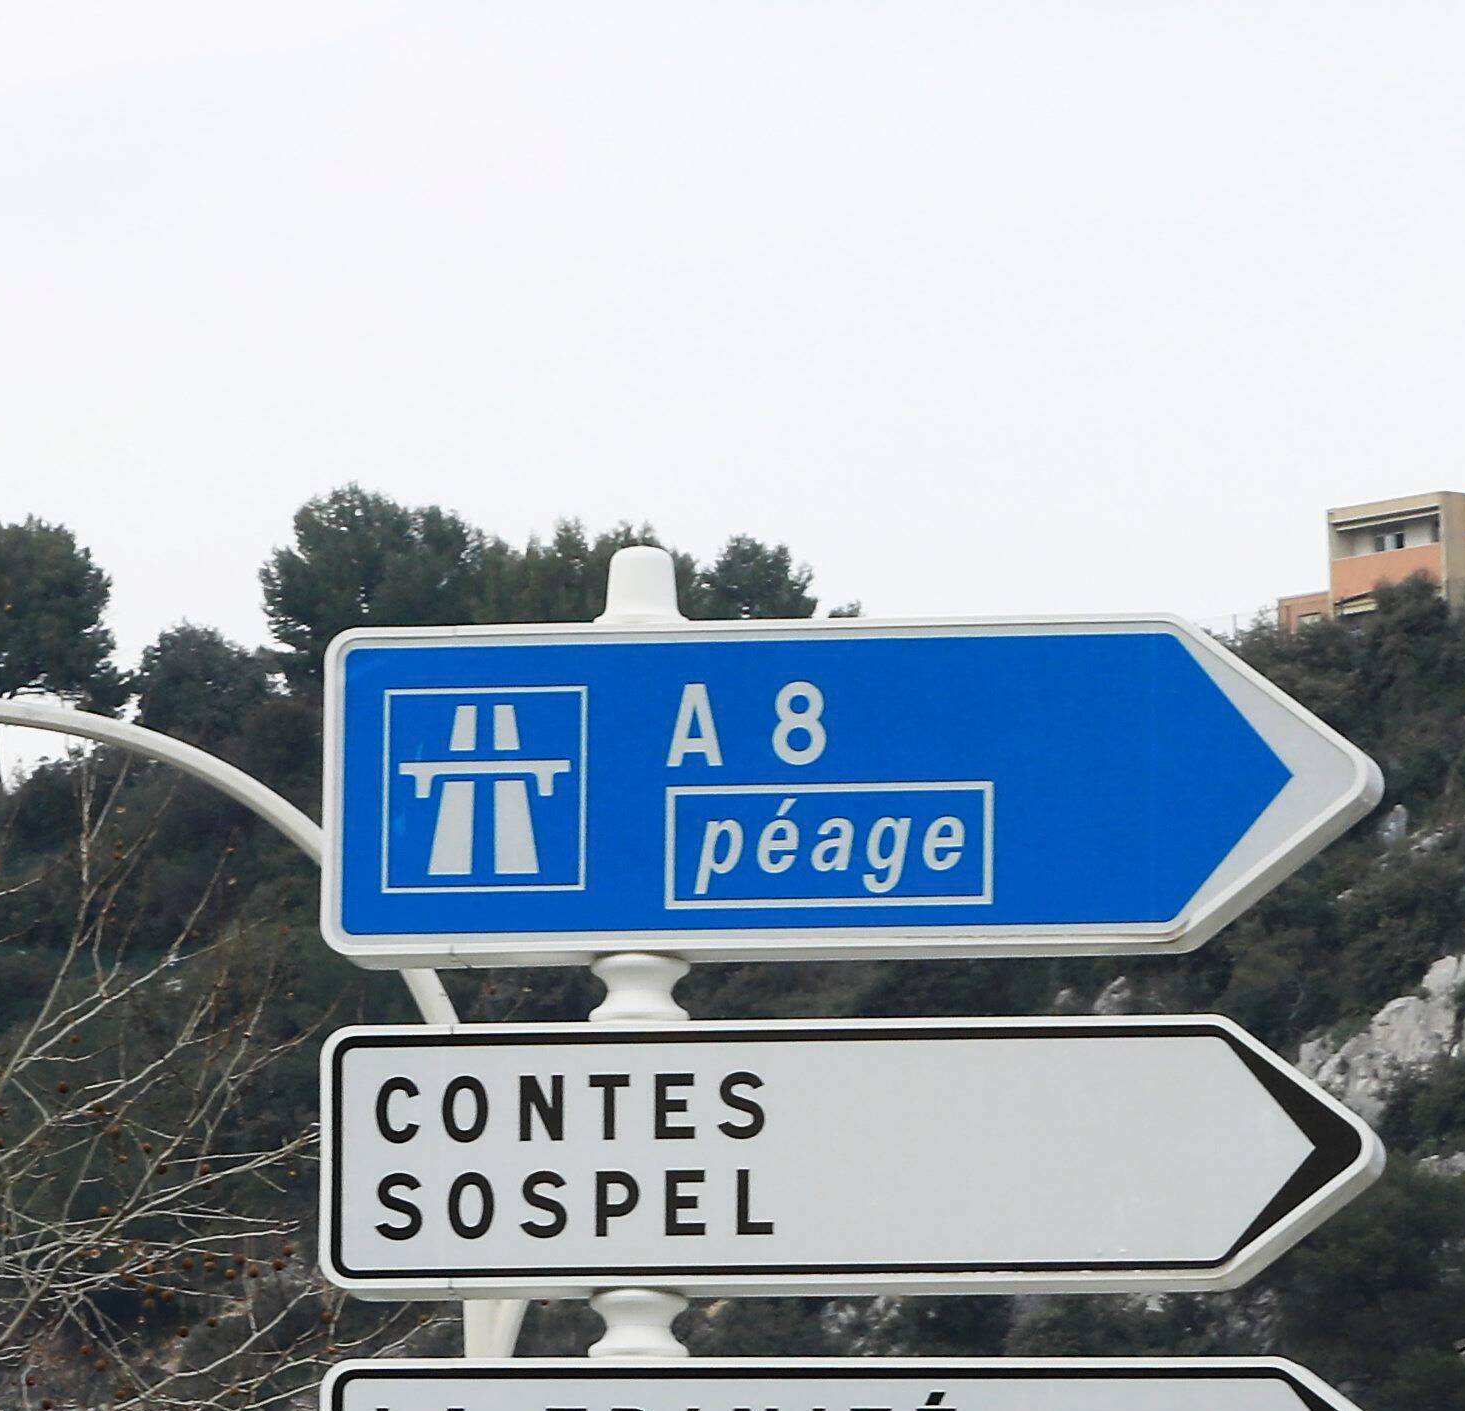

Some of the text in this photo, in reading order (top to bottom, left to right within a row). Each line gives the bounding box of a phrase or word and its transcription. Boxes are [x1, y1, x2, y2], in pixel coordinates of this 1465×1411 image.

[666, 681, 827, 767] A 8
[692, 795, 967, 895] péage
[375, 1071, 765, 1145] CONTES
[374, 1168, 775, 1241] SOSPEL
